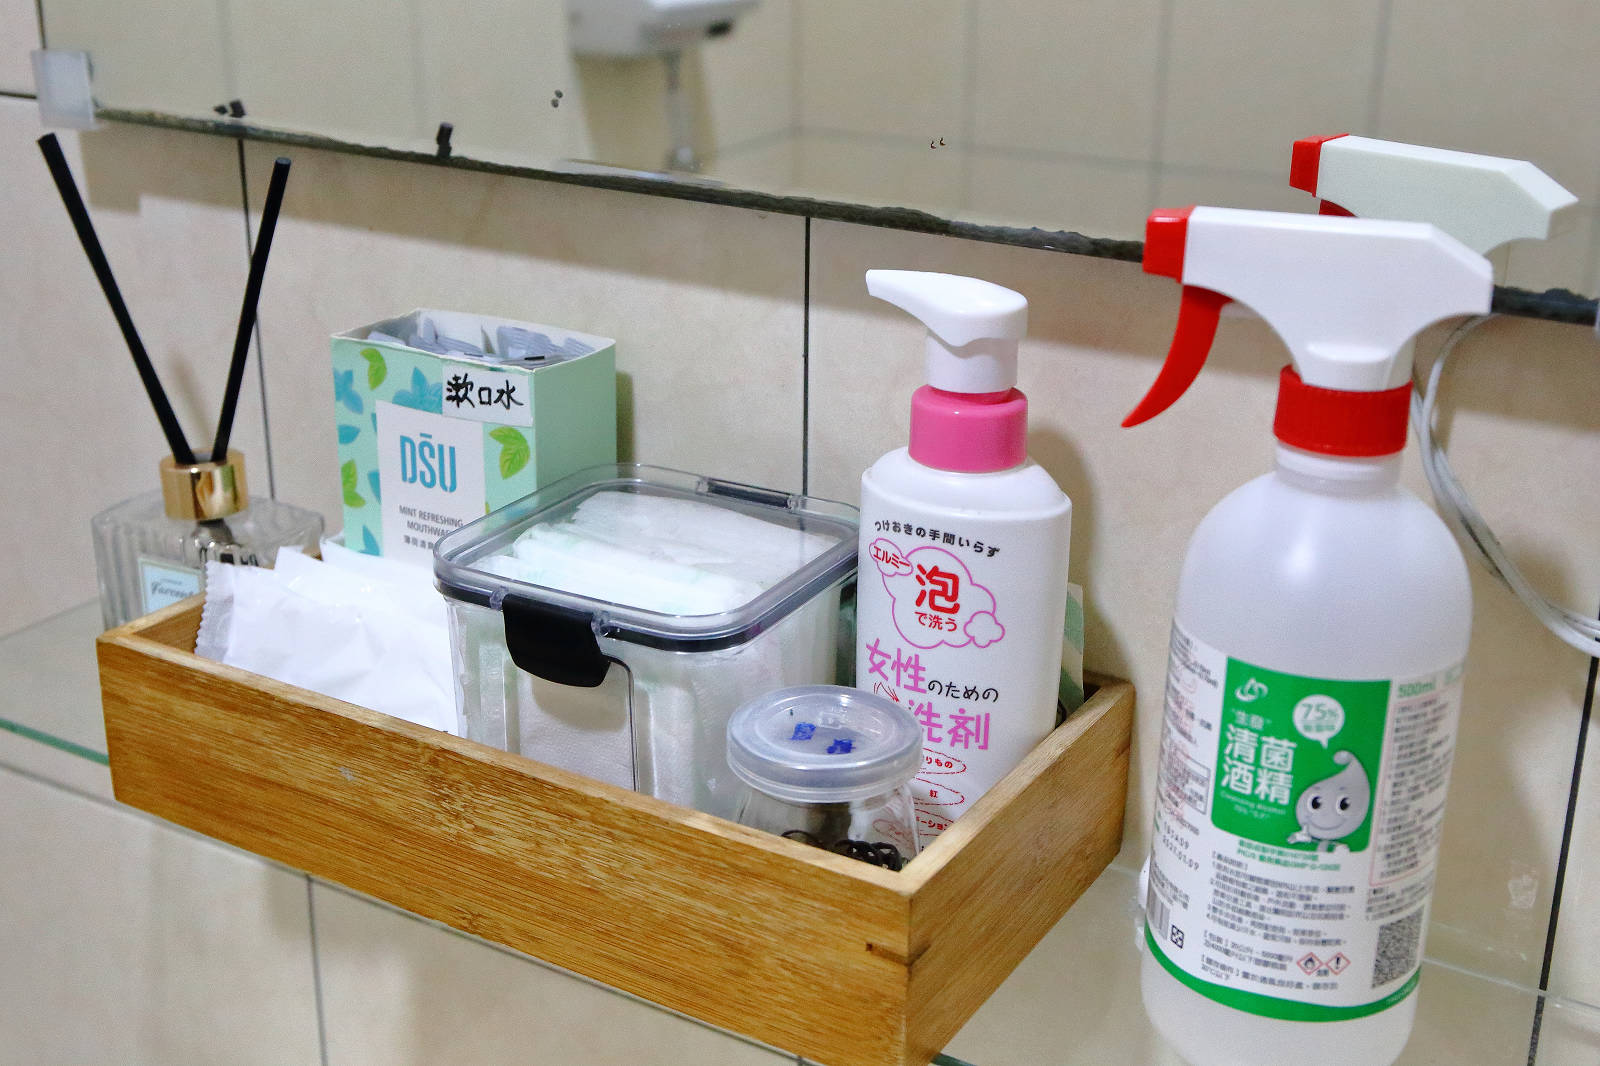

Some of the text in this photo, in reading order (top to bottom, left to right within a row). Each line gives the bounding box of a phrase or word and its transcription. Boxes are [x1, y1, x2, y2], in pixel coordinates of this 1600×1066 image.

[446, 373, 524, 410] 漱口水
[399, 505, 464, 527] MINT REFRESHING
[874, 519, 1000, 558] つけおきの手間いらず
[873, 545, 910, 569] エルミー
[915, 564, 960, 614] 泡
[914, 611, 958, 632] で洗う
[922, 755, 953, 769] りもの
